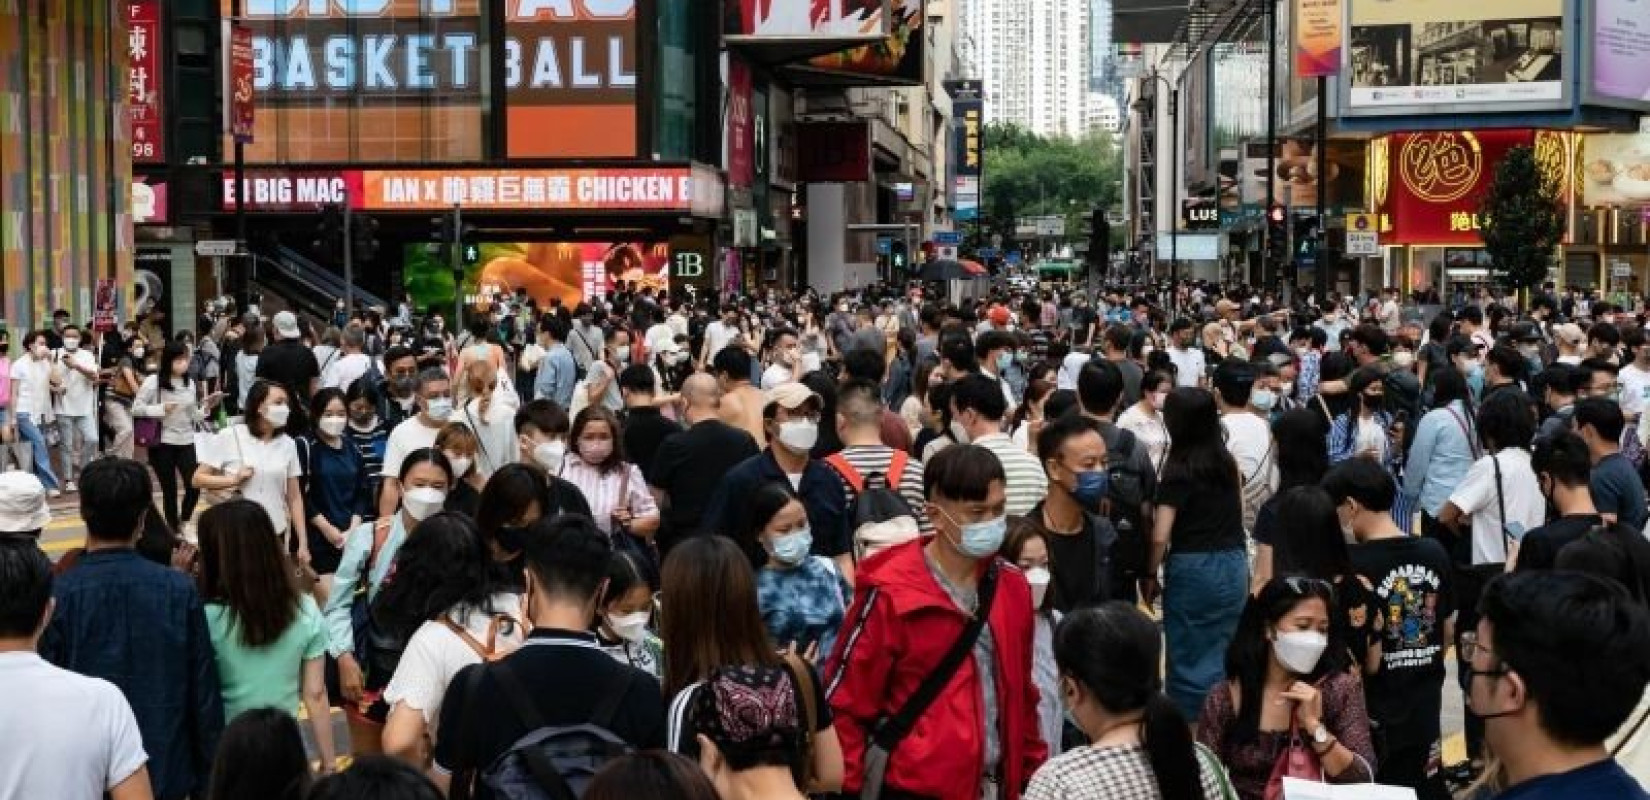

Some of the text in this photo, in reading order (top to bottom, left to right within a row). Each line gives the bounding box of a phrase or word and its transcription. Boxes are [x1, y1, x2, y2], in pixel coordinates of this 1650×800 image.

[252, 35, 475, 89] BASKET
[505, 37, 636, 88] BALL
[255, 177, 292, 203] BIG
[296, 177, 345, 203] MAC
[383, 177, 420, 203] IAN
[577, 176, 673, 203] CHICKEN
